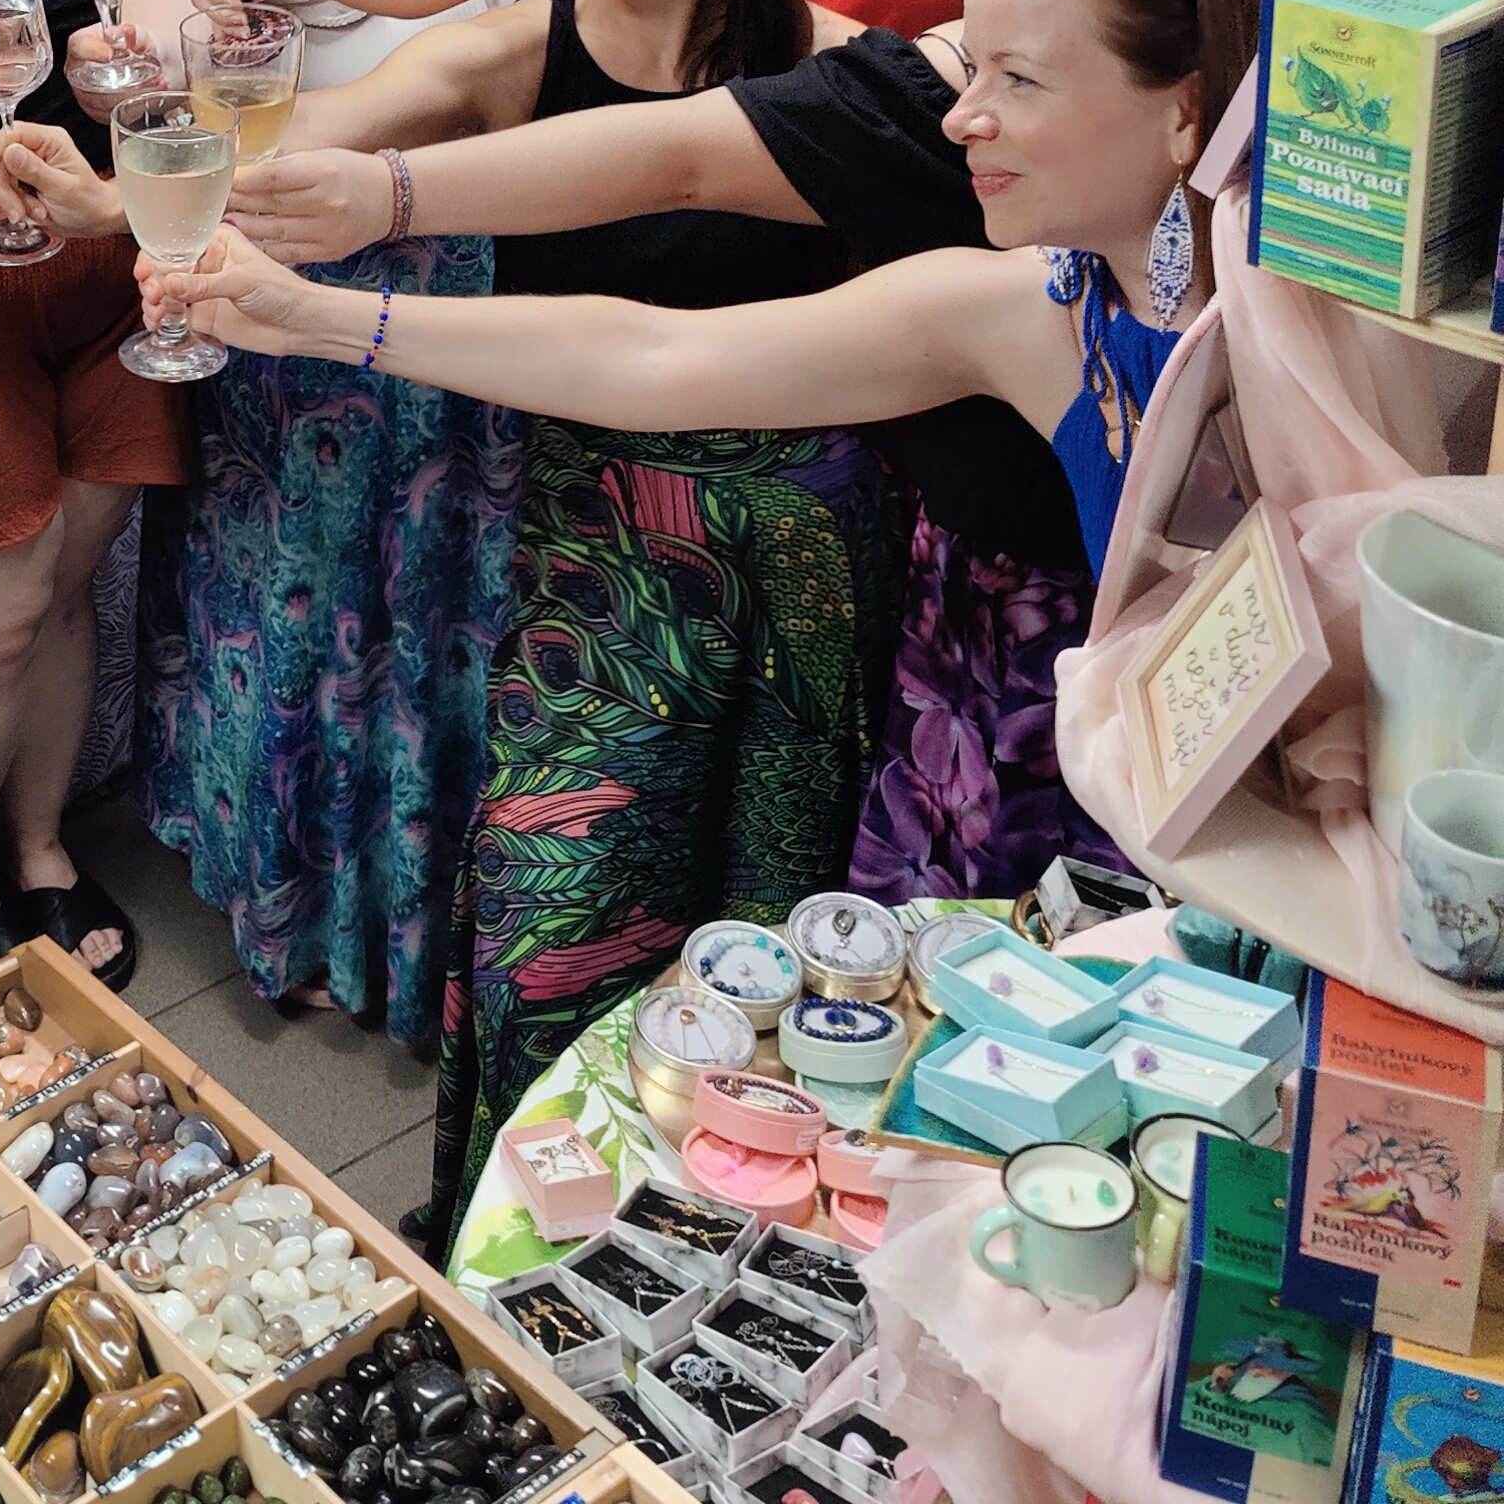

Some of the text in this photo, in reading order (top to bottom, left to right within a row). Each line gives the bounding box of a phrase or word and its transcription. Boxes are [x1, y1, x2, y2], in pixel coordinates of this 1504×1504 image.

[1298, 127, 1378, 163] Bylinná
[1269, 141, 1405, 197] Poznávací
[1296, 174, 1372, 212] sada
[1191, 1410, 1250, 1437] nápoj
[1194, 1393, 1296, 1435] Kouzelný
